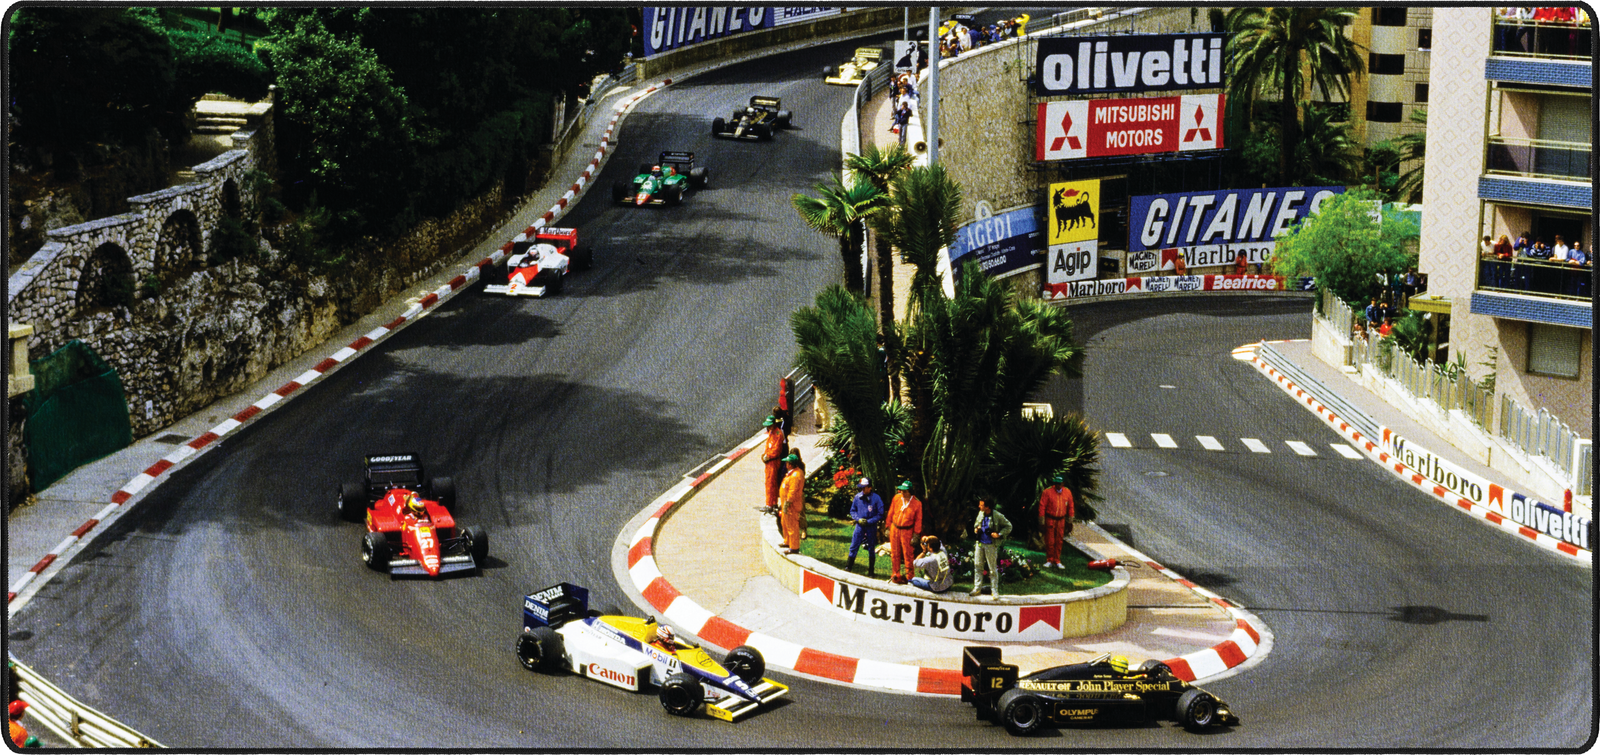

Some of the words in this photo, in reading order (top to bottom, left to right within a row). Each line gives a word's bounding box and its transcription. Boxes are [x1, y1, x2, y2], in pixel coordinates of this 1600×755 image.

[1043, 38, 1222, 91] olivetti
[1094, 103, 1175, 125] MITSUBISHI
[1106, 128, 1163, 149] MOTORS
[967, 214, 1012, 253] AGEDI
[1053, 246, 1091, 276] Agip
[1067, 279, 1126, 298] Marlboro
[1212, 274, 1276, 290] Beatrice
[370, 455, 412, 463] GOODYEAR
[1392, 434, 1483, 502] Marlboro
[1512, 496, 1588, 548] olivetti
[420, 538, 434, 549] 27
[524, 599, 549, 618] DENIM
[836, 582, 1013, 634] Marlboro
[644, 647, 668, 665] Mobil
[588, 662, 635, 687] Canon
[991, 677, 1004, 689] 12
[1018, 681, 1057, 691] RENAULT
[1076, 680, 1101, 691] John
[1103, 680, 1134, 694] Player
[1136, 680, 1170, 693] Special
